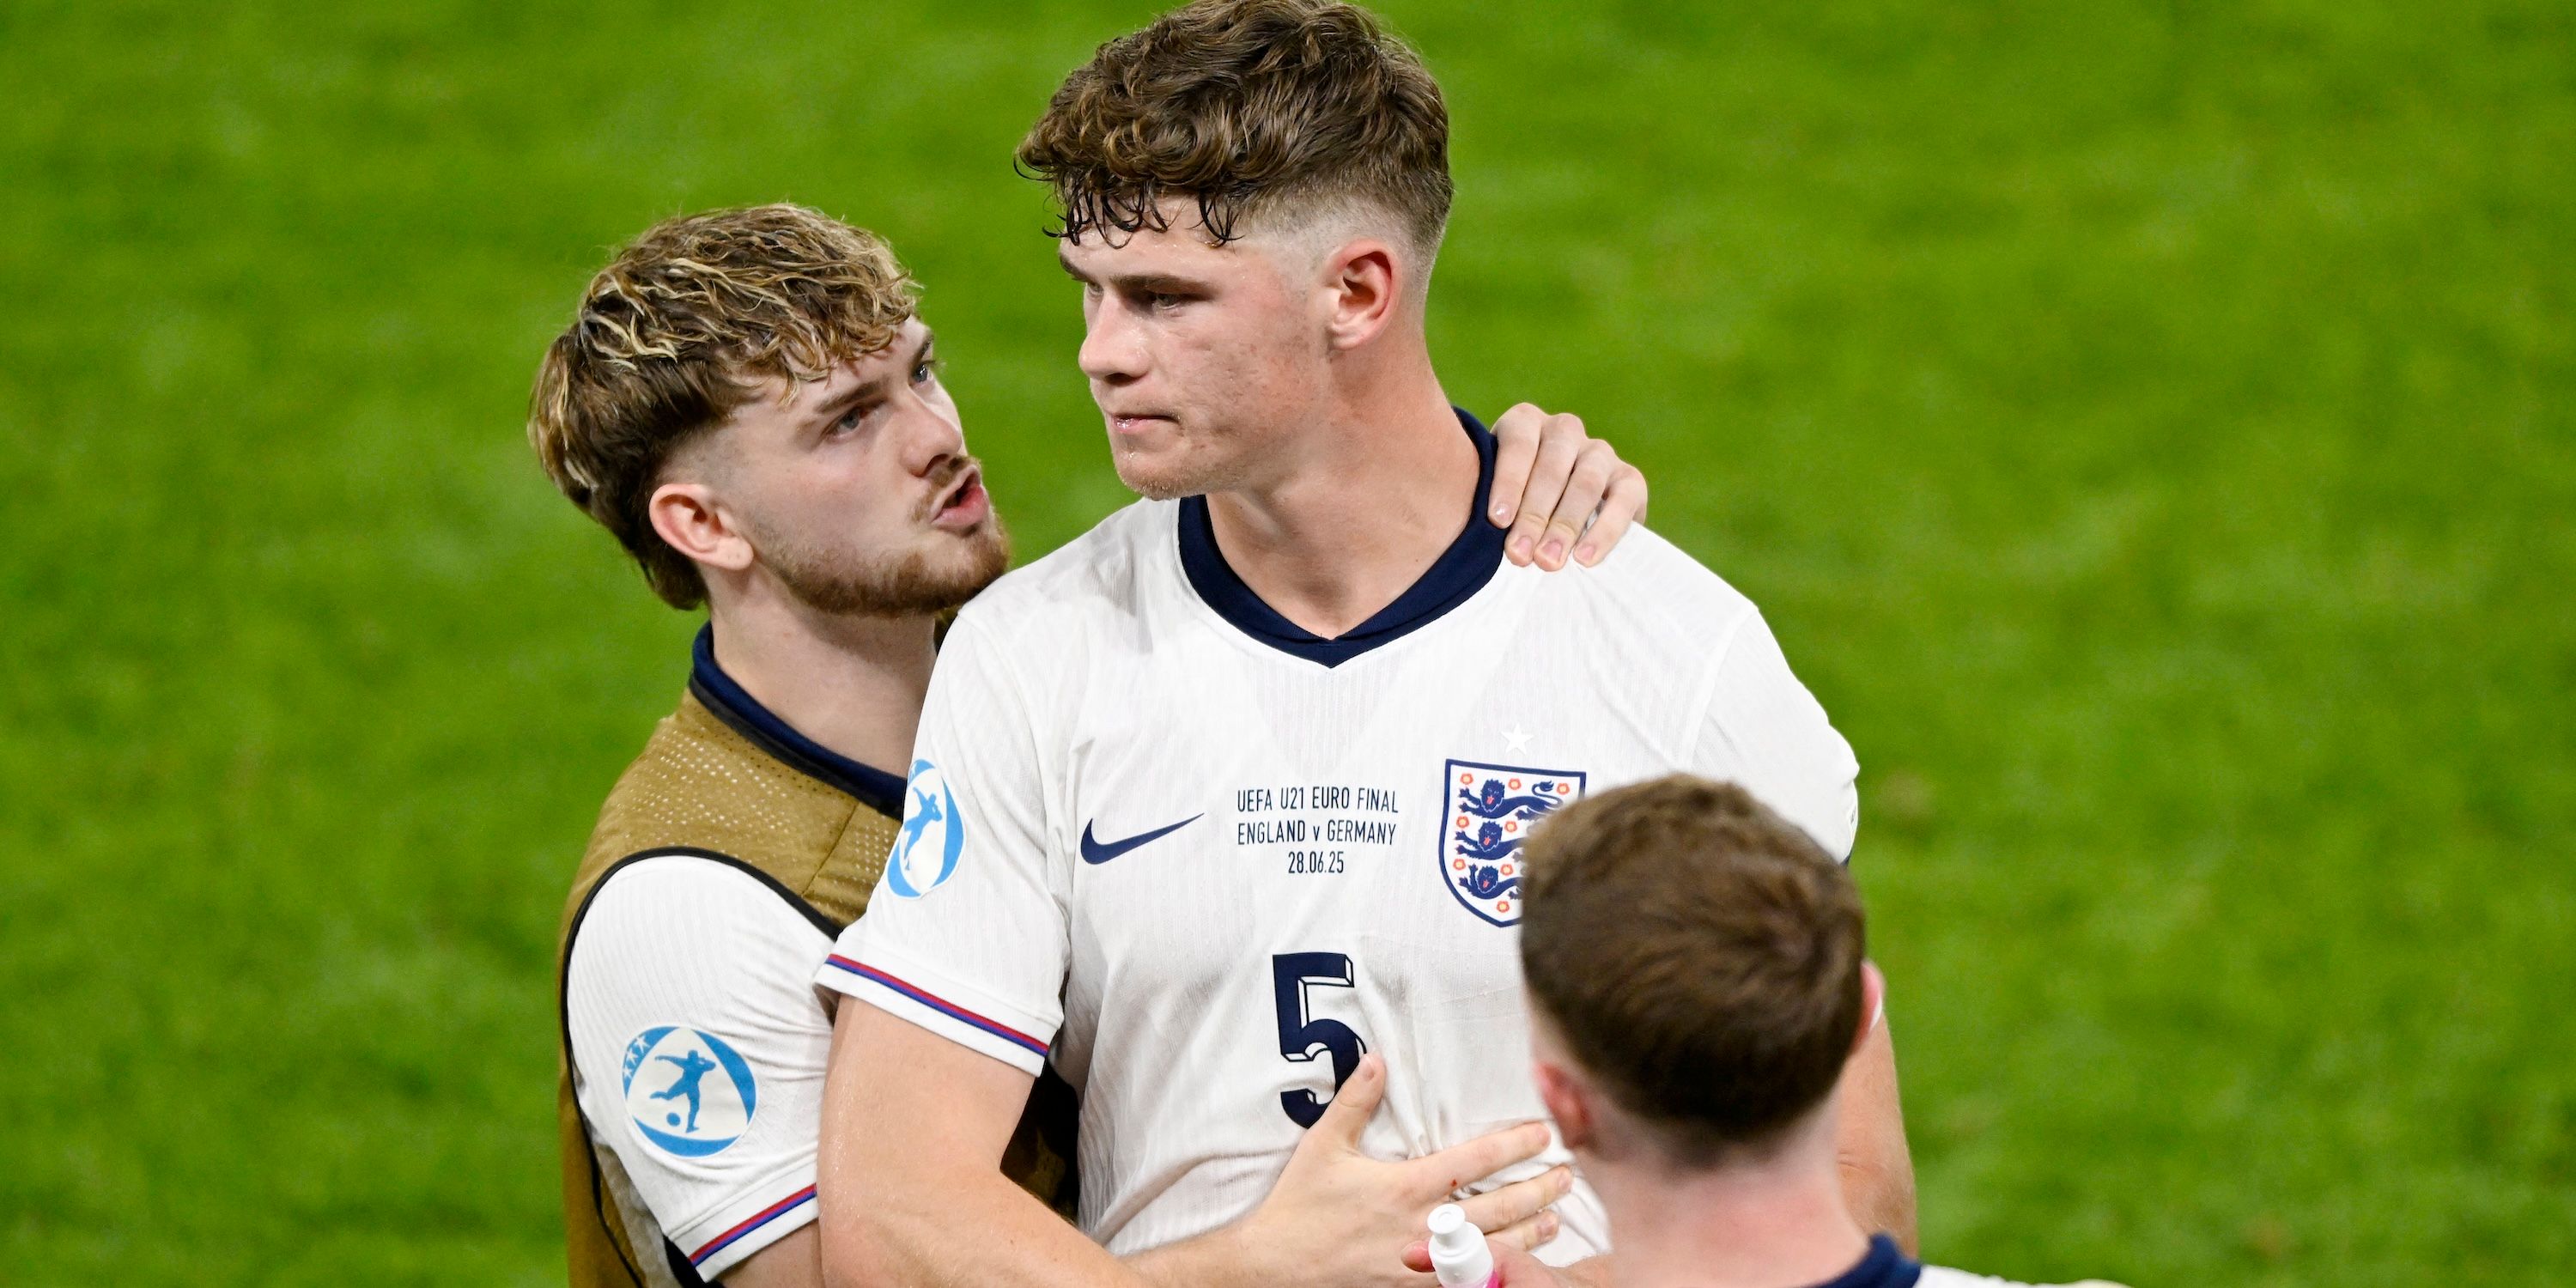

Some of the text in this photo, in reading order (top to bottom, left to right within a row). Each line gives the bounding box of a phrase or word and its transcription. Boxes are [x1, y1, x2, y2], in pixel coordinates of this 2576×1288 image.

[1237, 786, 1399, 813] UEFA U21 EURO FINAL
[1237, 819, 1396, 845] ENGLAND v GERMANY
[1288, 850, 1344, 874] 28.06.25
[1273, 951, 1367, 1129] 5
